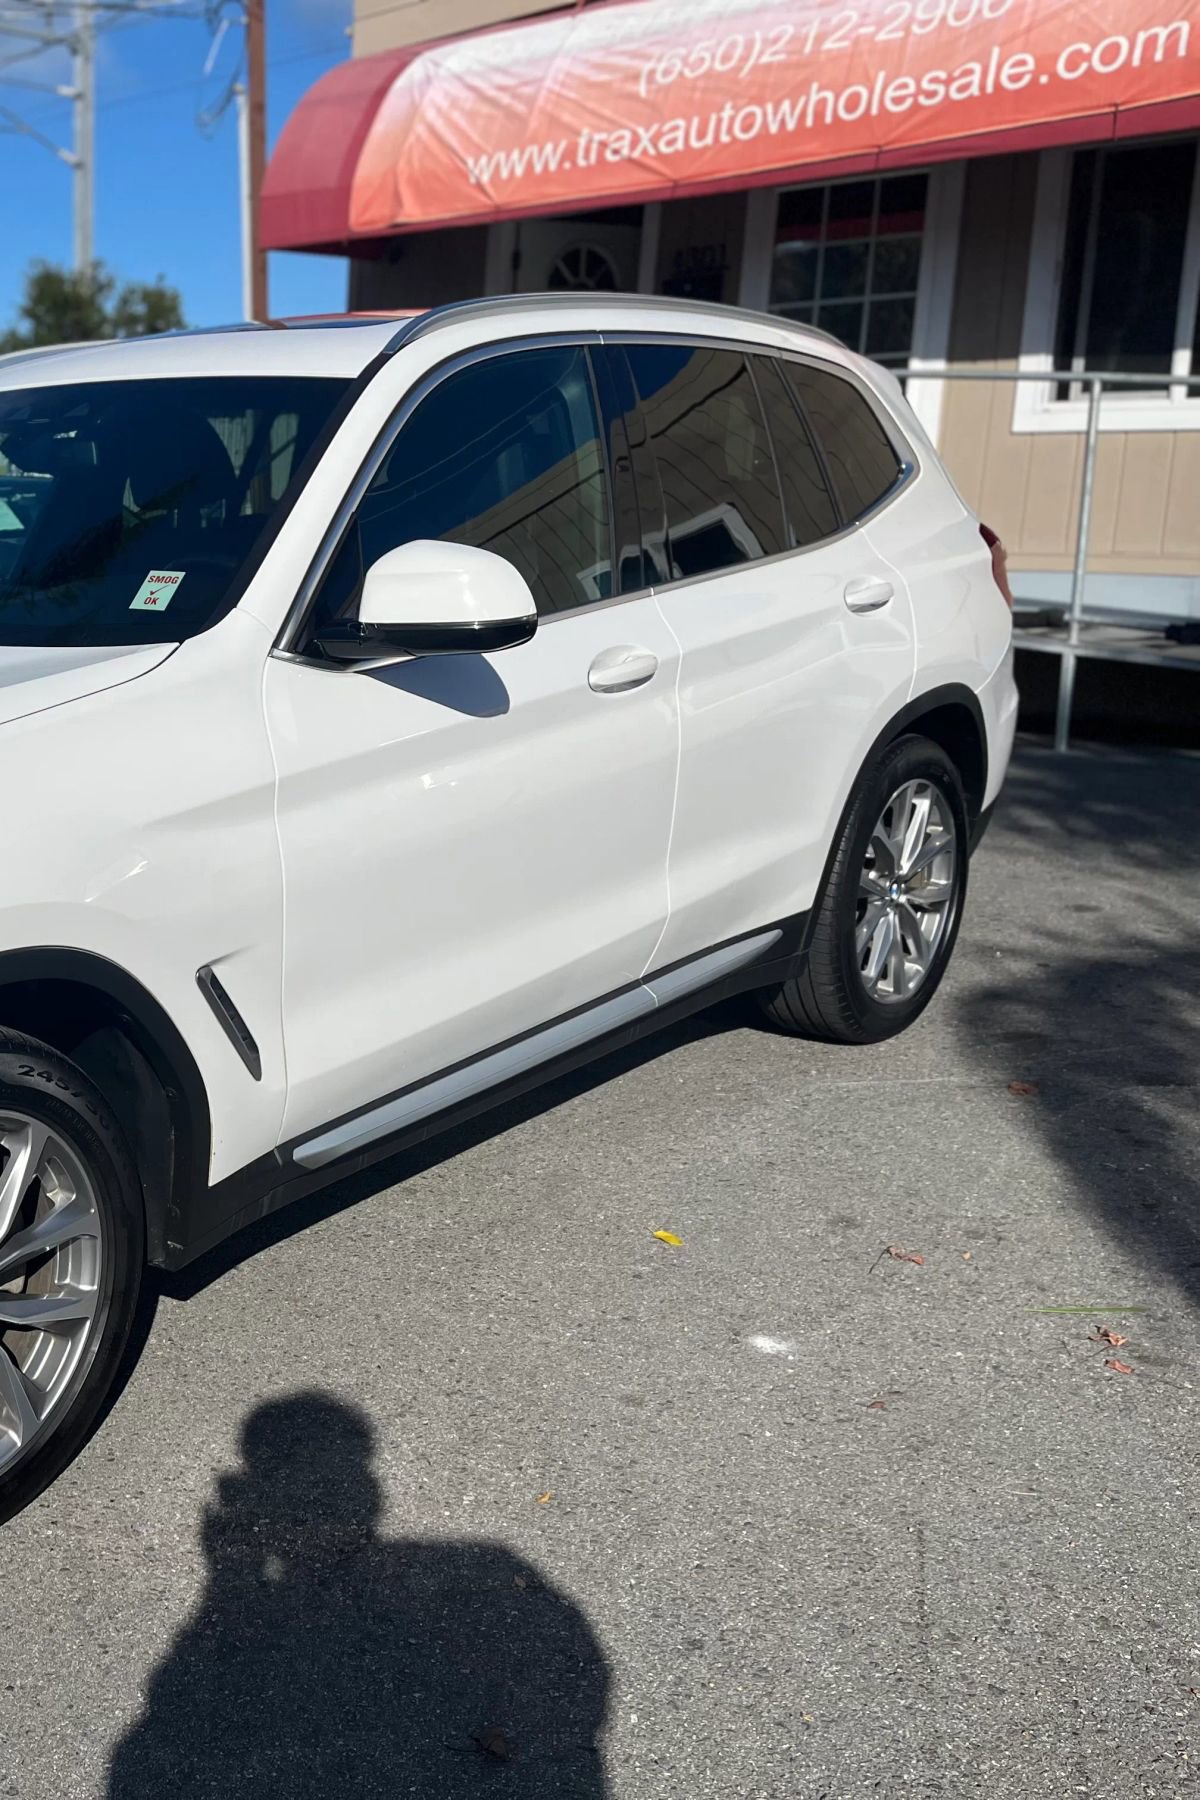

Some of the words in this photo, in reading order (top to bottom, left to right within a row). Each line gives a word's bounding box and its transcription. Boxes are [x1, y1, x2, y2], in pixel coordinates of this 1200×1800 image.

[464, 18, 1191, 184] www.traxautowholesale.com
[147, 575, 180, 584] SMOG
[143, 596, 160, 605] OK
